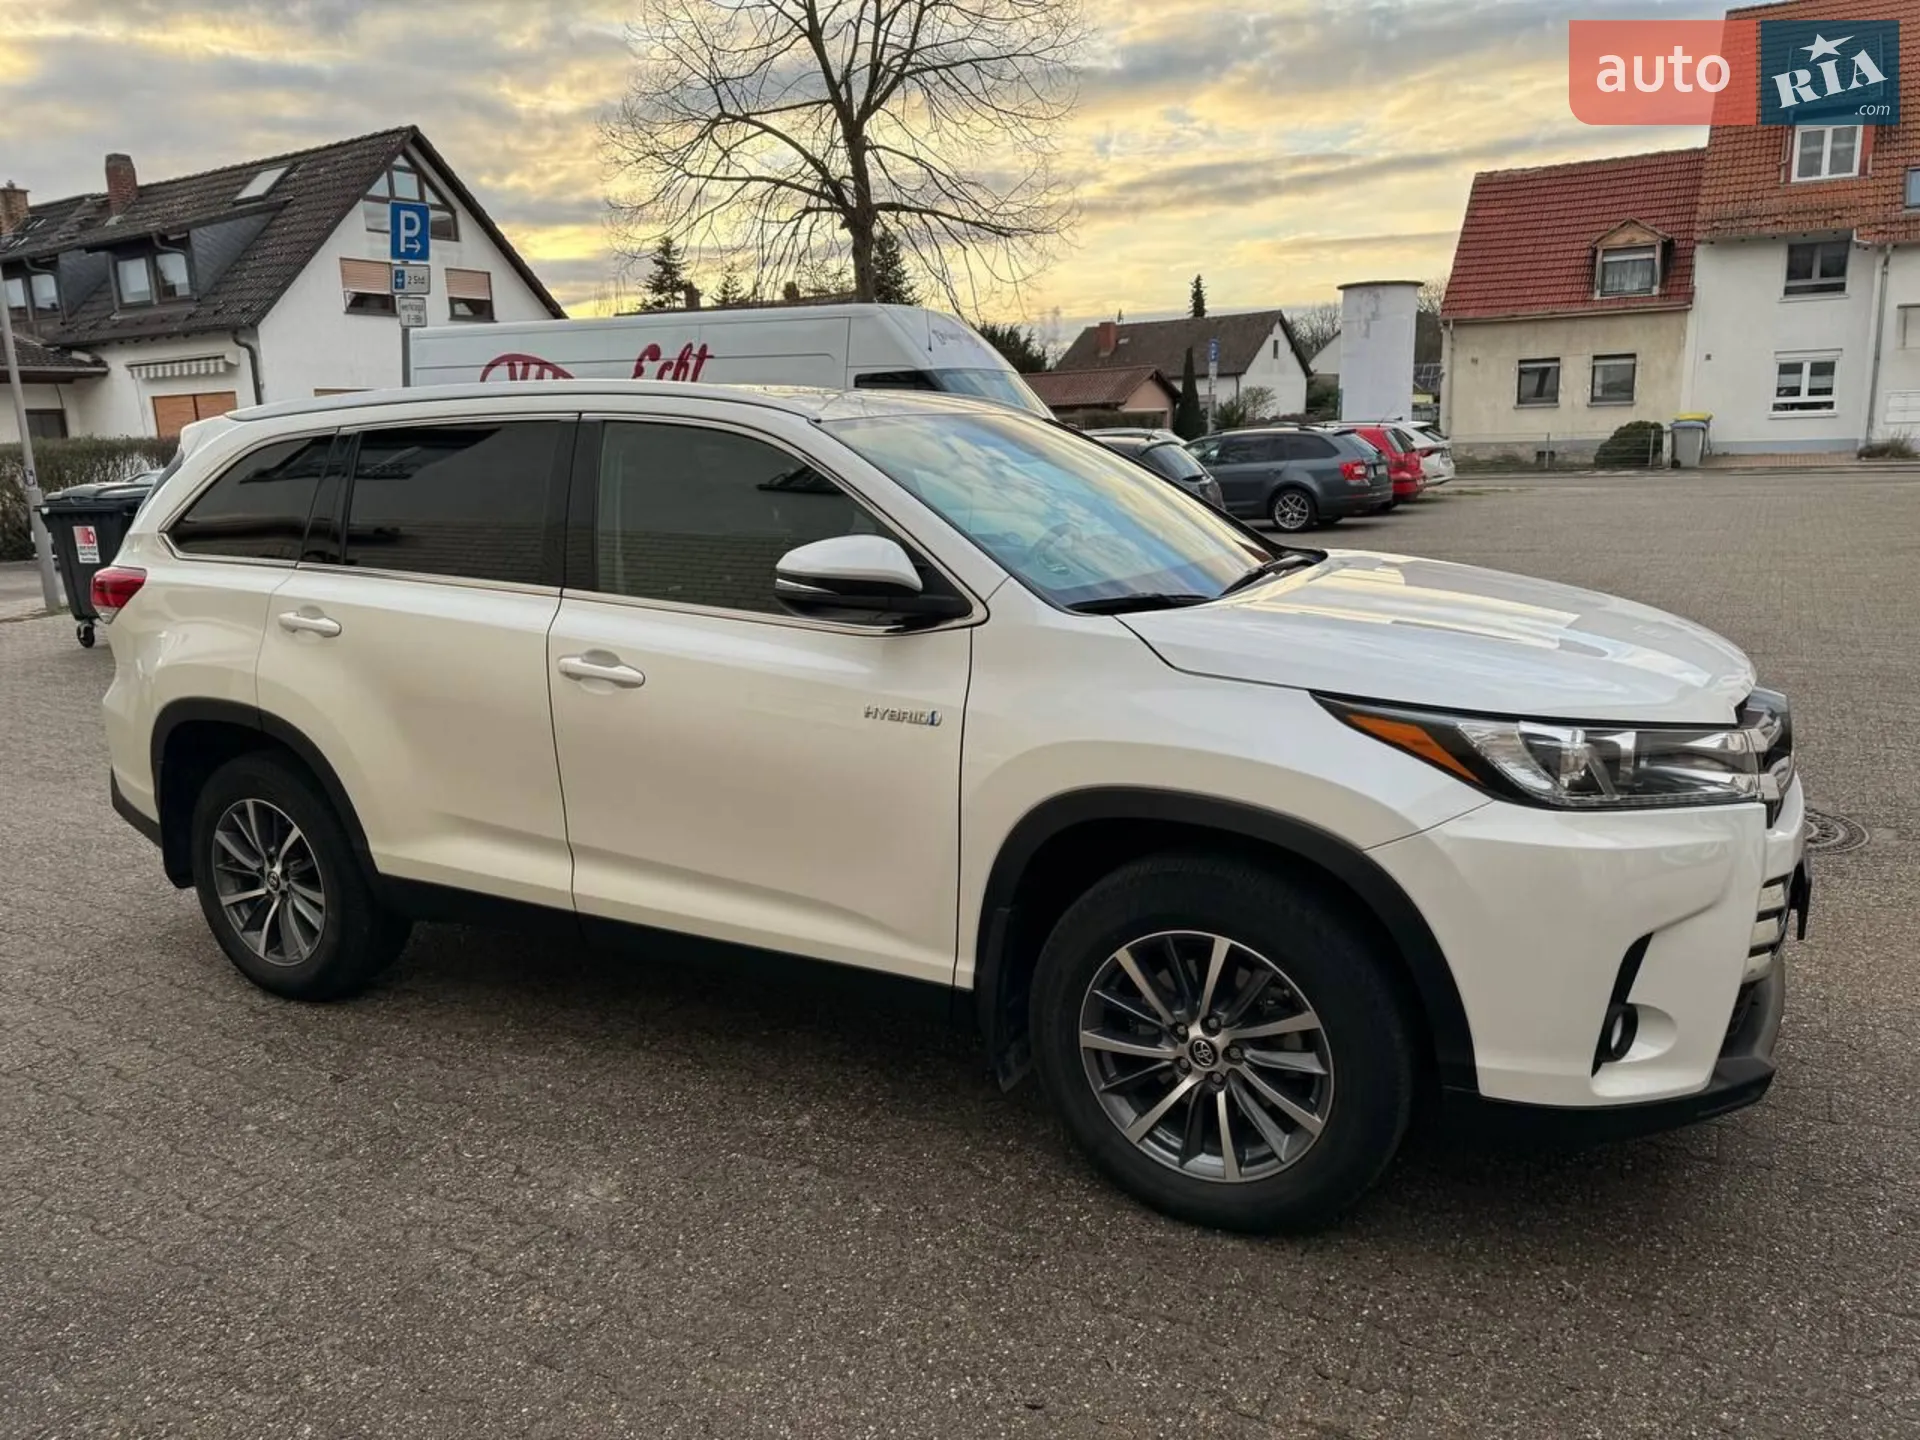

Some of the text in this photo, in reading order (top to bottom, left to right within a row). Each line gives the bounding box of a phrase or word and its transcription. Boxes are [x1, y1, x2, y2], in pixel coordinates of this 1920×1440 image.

[400, 210, 420, 252] P
[407, 275, 412, 285] 2
[863, 704, 928, 725] HYBRID
